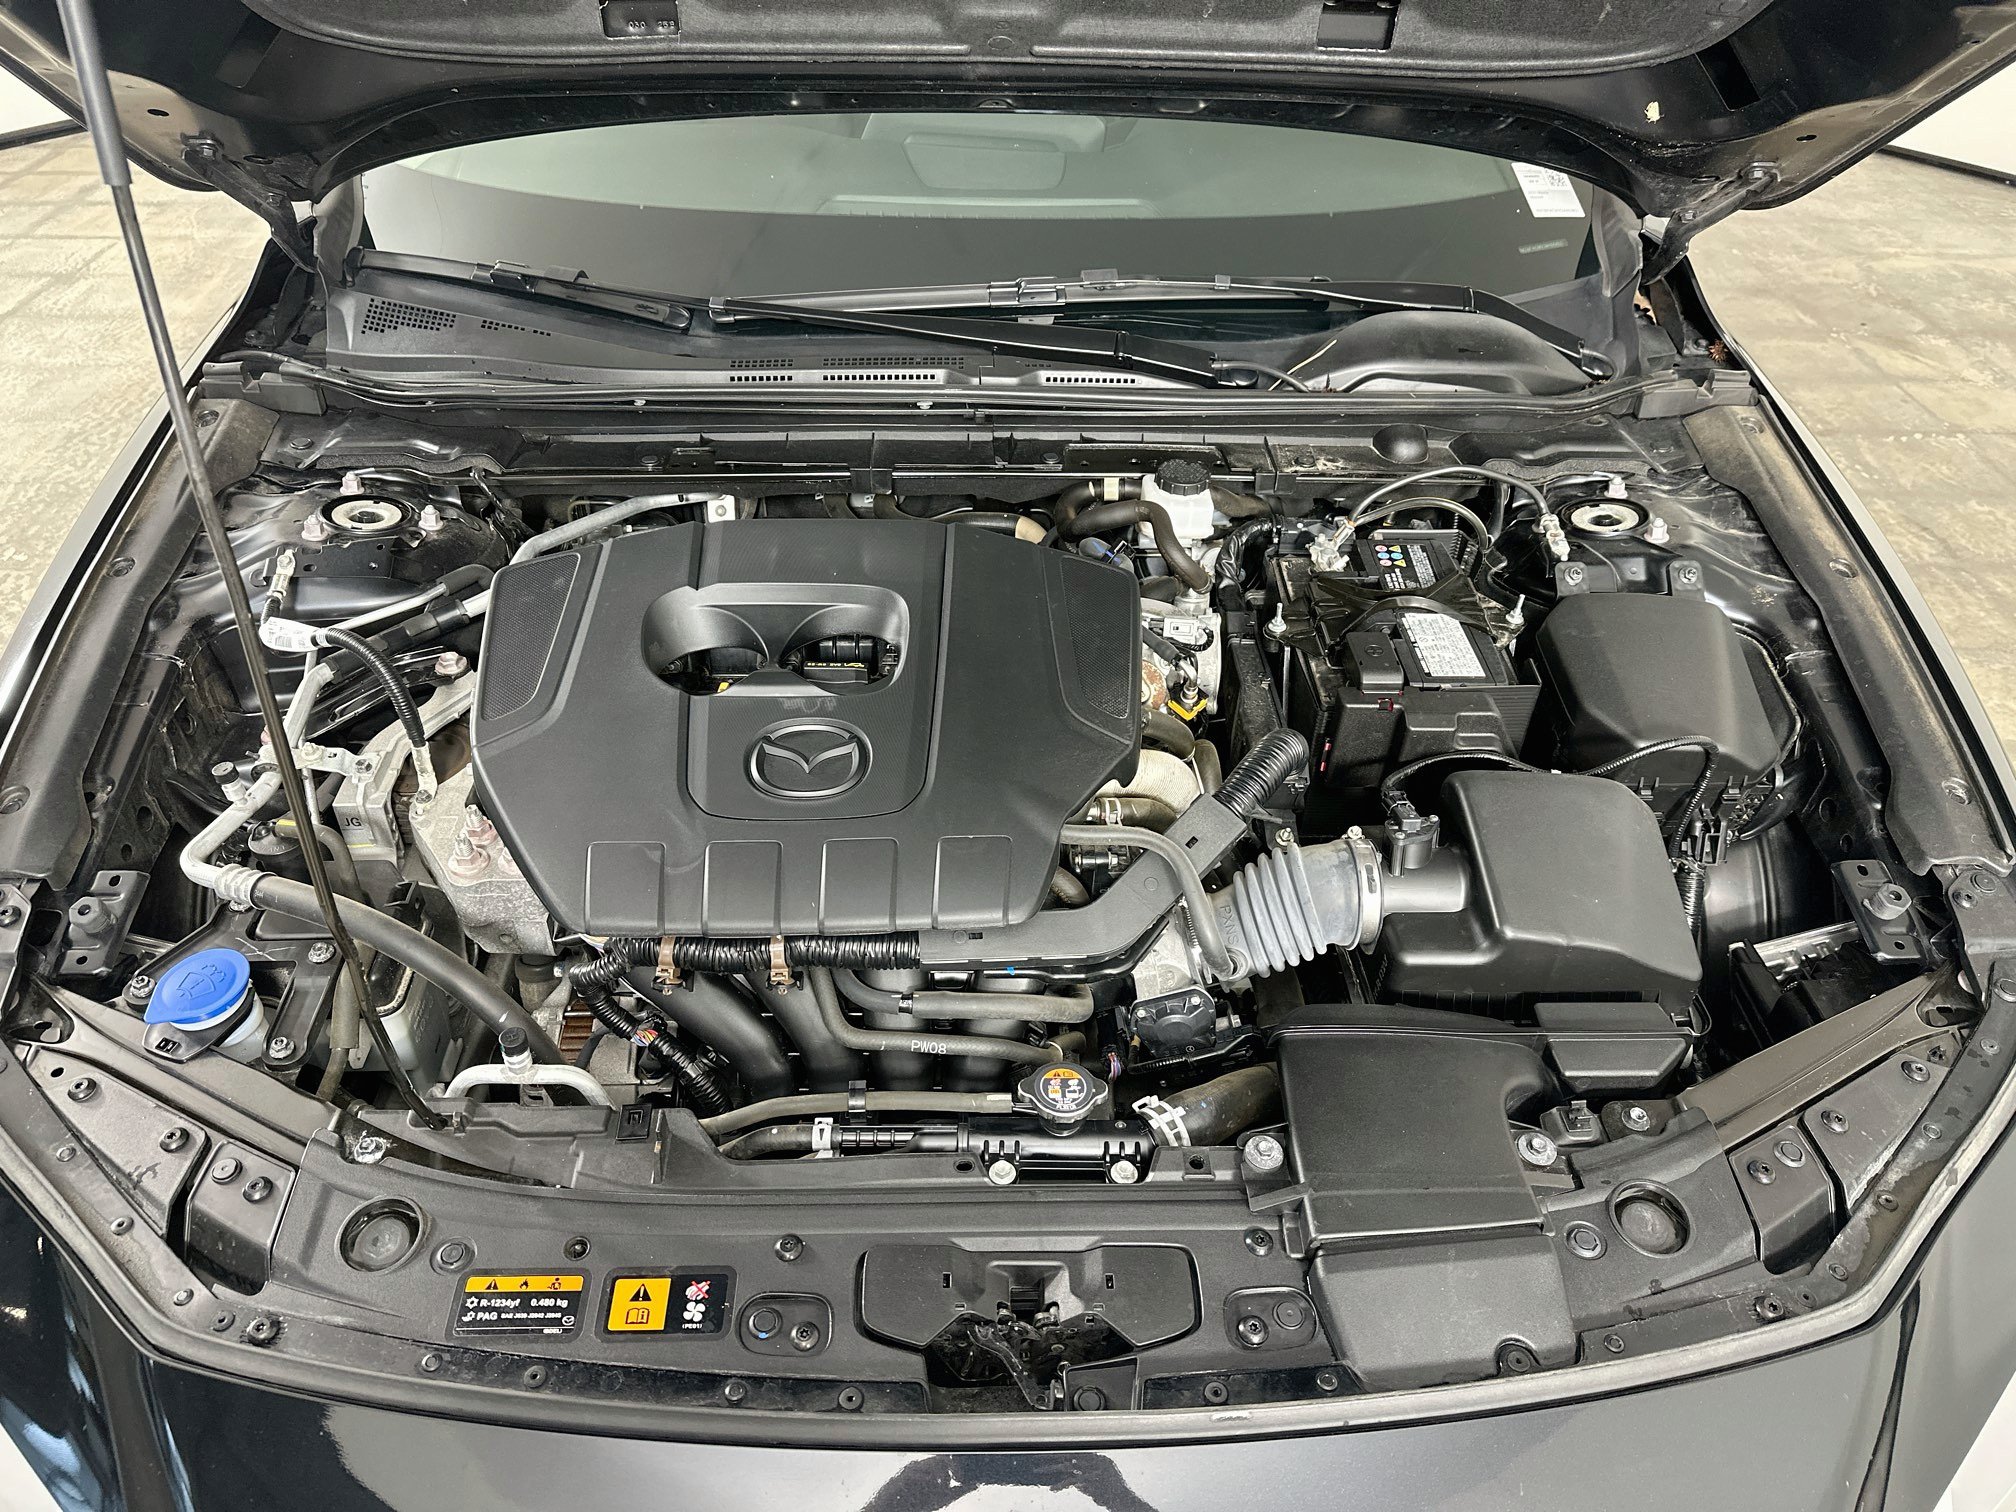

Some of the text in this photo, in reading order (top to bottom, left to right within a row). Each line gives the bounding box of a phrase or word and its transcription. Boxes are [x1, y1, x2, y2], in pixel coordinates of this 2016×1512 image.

[345, 817, 362, 827] JG
[911, 1040, 947, 1055] PW08
[480, 1298, 569, 1308] R-1234yf 0.480 kg
[477, 1311, 498, 1321] PAG
